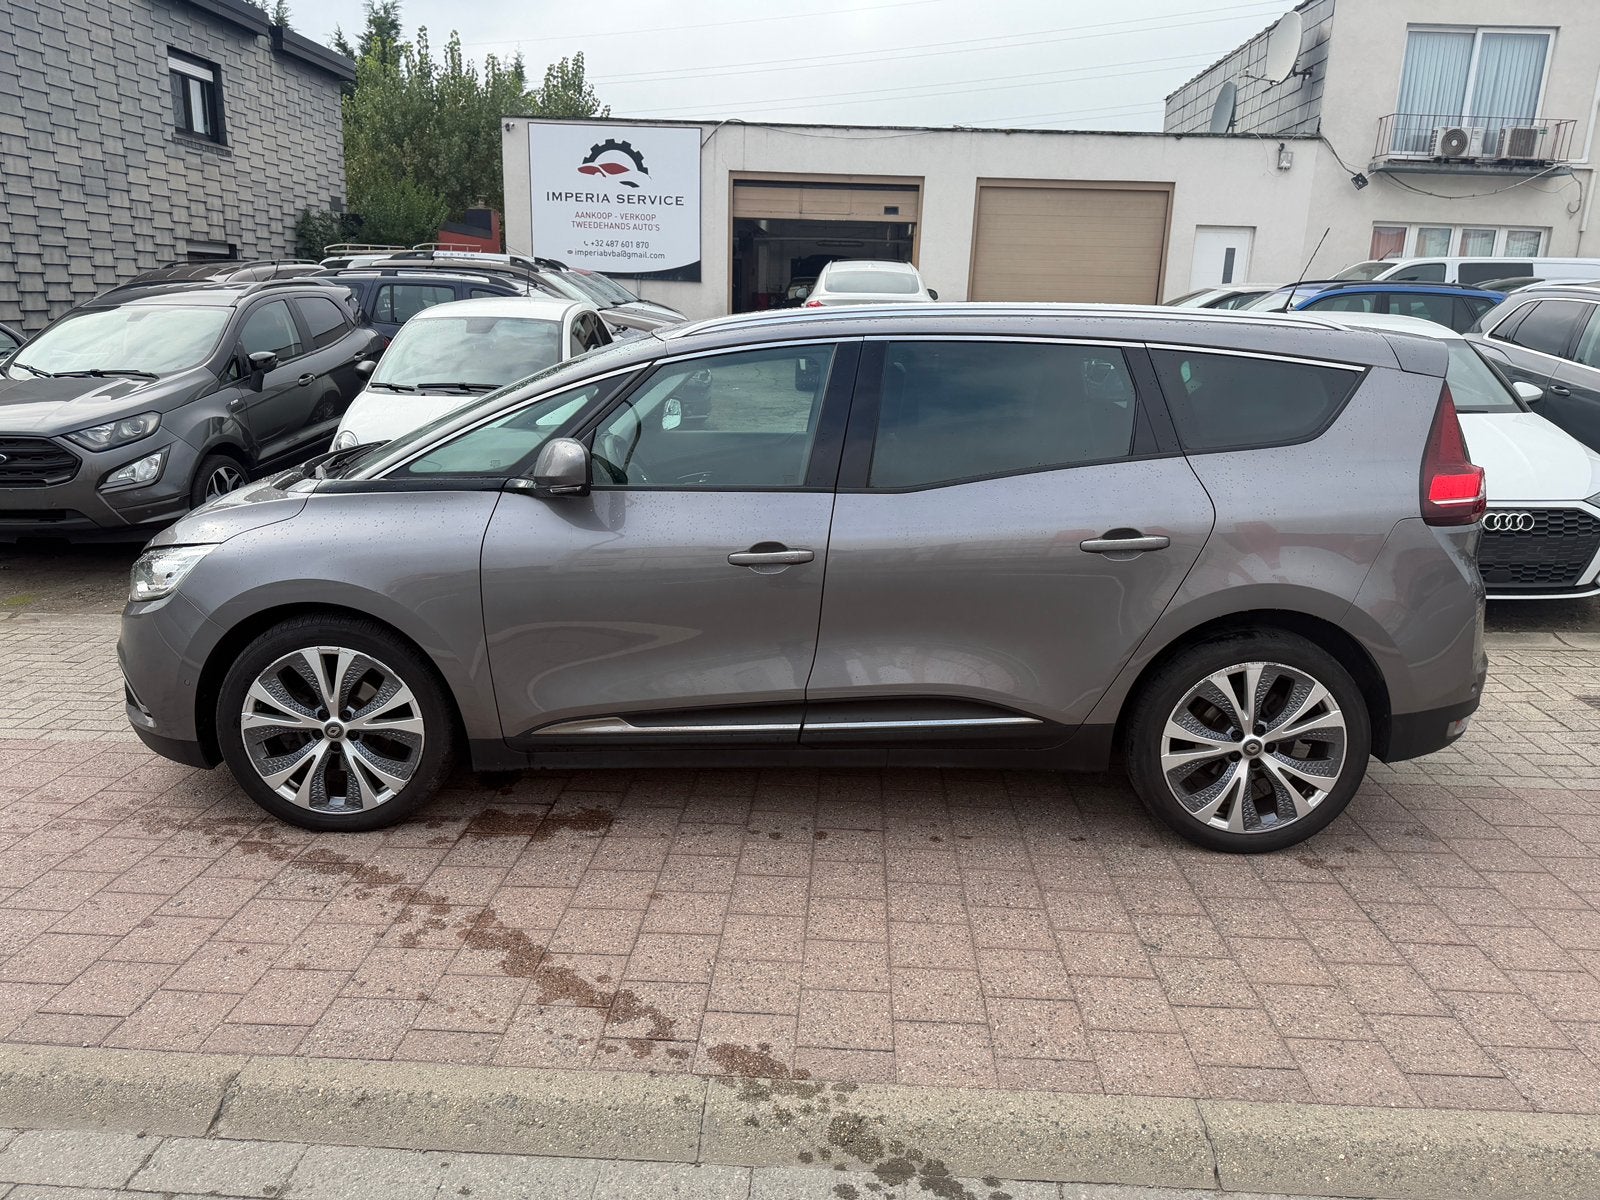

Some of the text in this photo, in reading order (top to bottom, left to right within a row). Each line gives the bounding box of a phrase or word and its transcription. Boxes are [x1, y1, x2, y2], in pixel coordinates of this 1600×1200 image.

[546, 191, 685, 206] IMPERIA SERVICE
[574, 211, 612, 219] AANKOOP
[620, 213, 657, 221] VERKOOP
[571, 221, 660, 231] TWEEDEHANDS AUTO'S
[605, 240, 619, 248] 487
[635, 241, 650, 249] 870
[574, 249, 666, 259] imperiabvba@gmail.com
